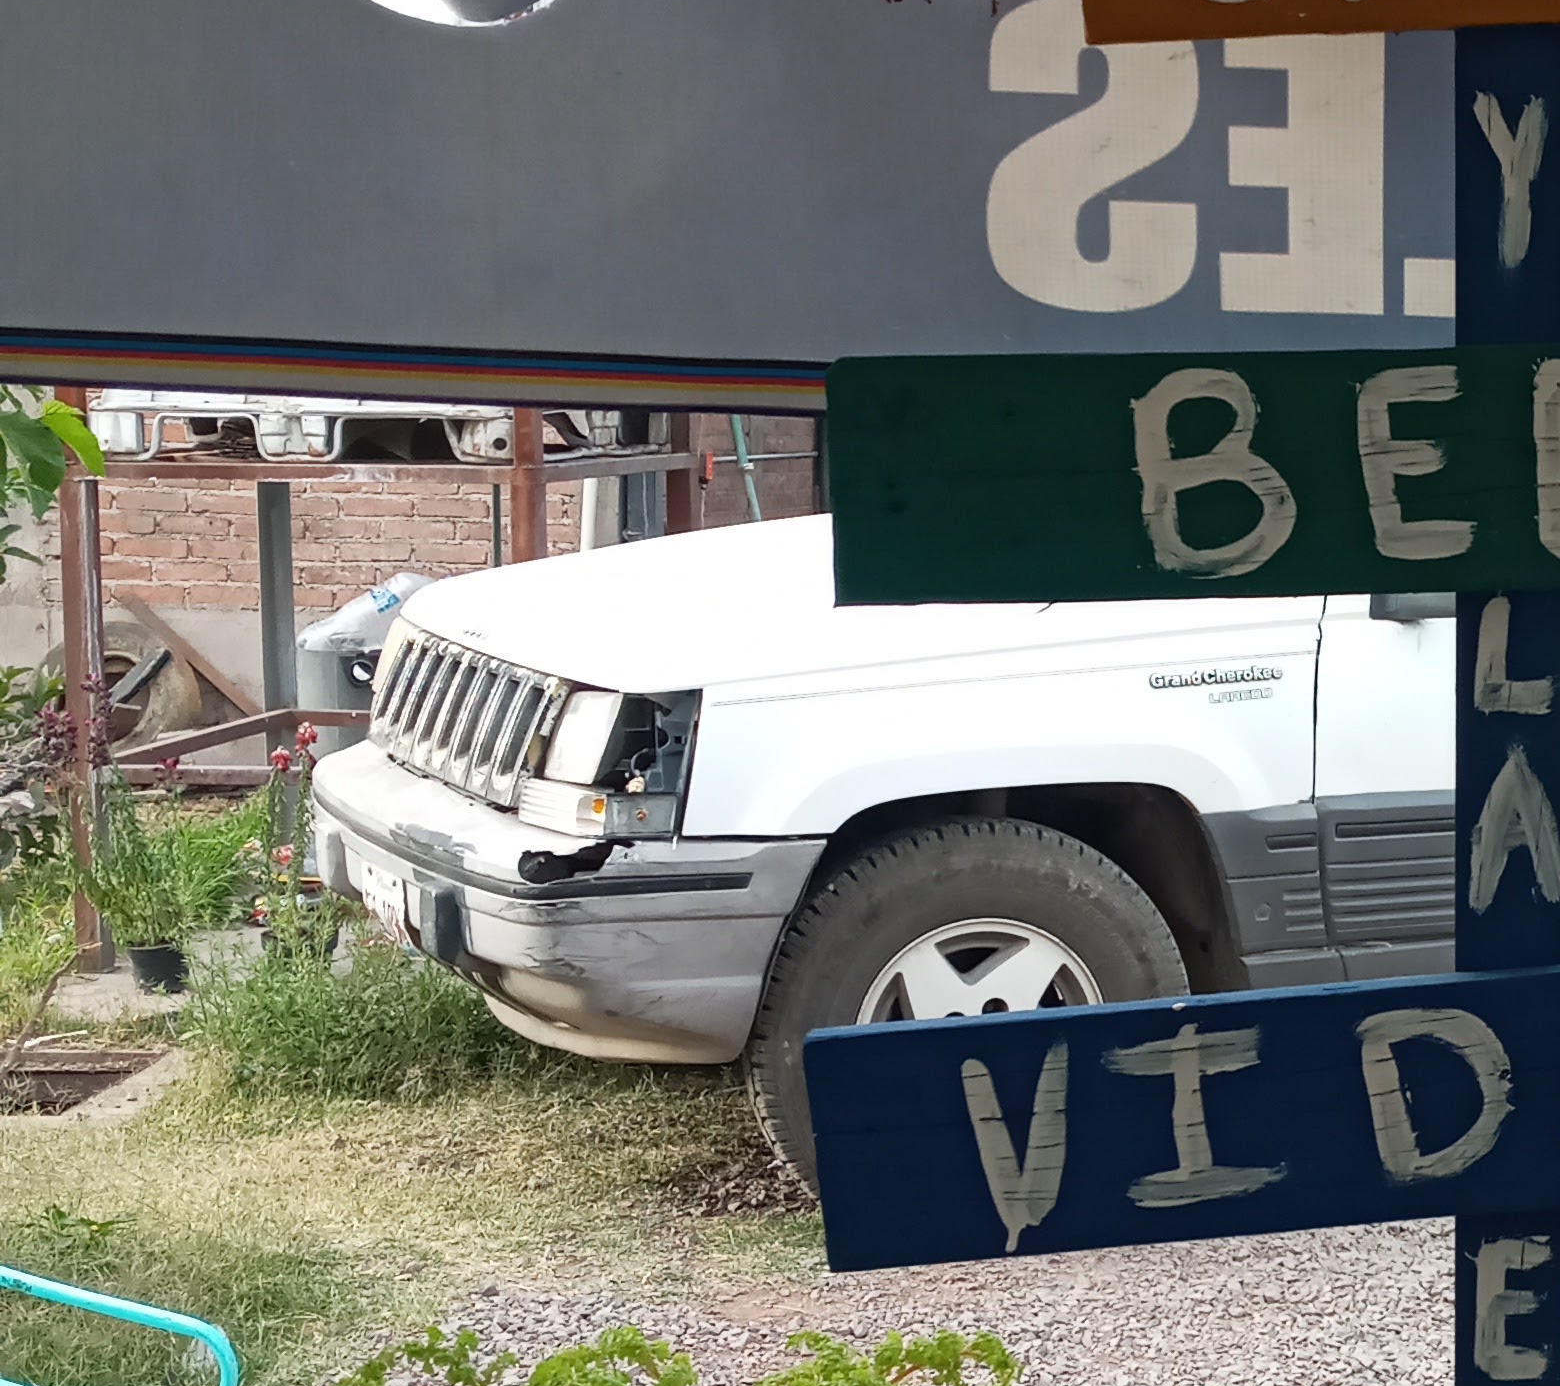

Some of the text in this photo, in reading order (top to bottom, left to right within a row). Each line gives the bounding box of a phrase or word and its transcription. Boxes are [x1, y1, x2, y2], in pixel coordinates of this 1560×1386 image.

[1472, 89, 1550, 273] Y
[1149, 664, 1284, 690] Grand Cherokee
[1208, 687, 1273, 704] LAREDO
